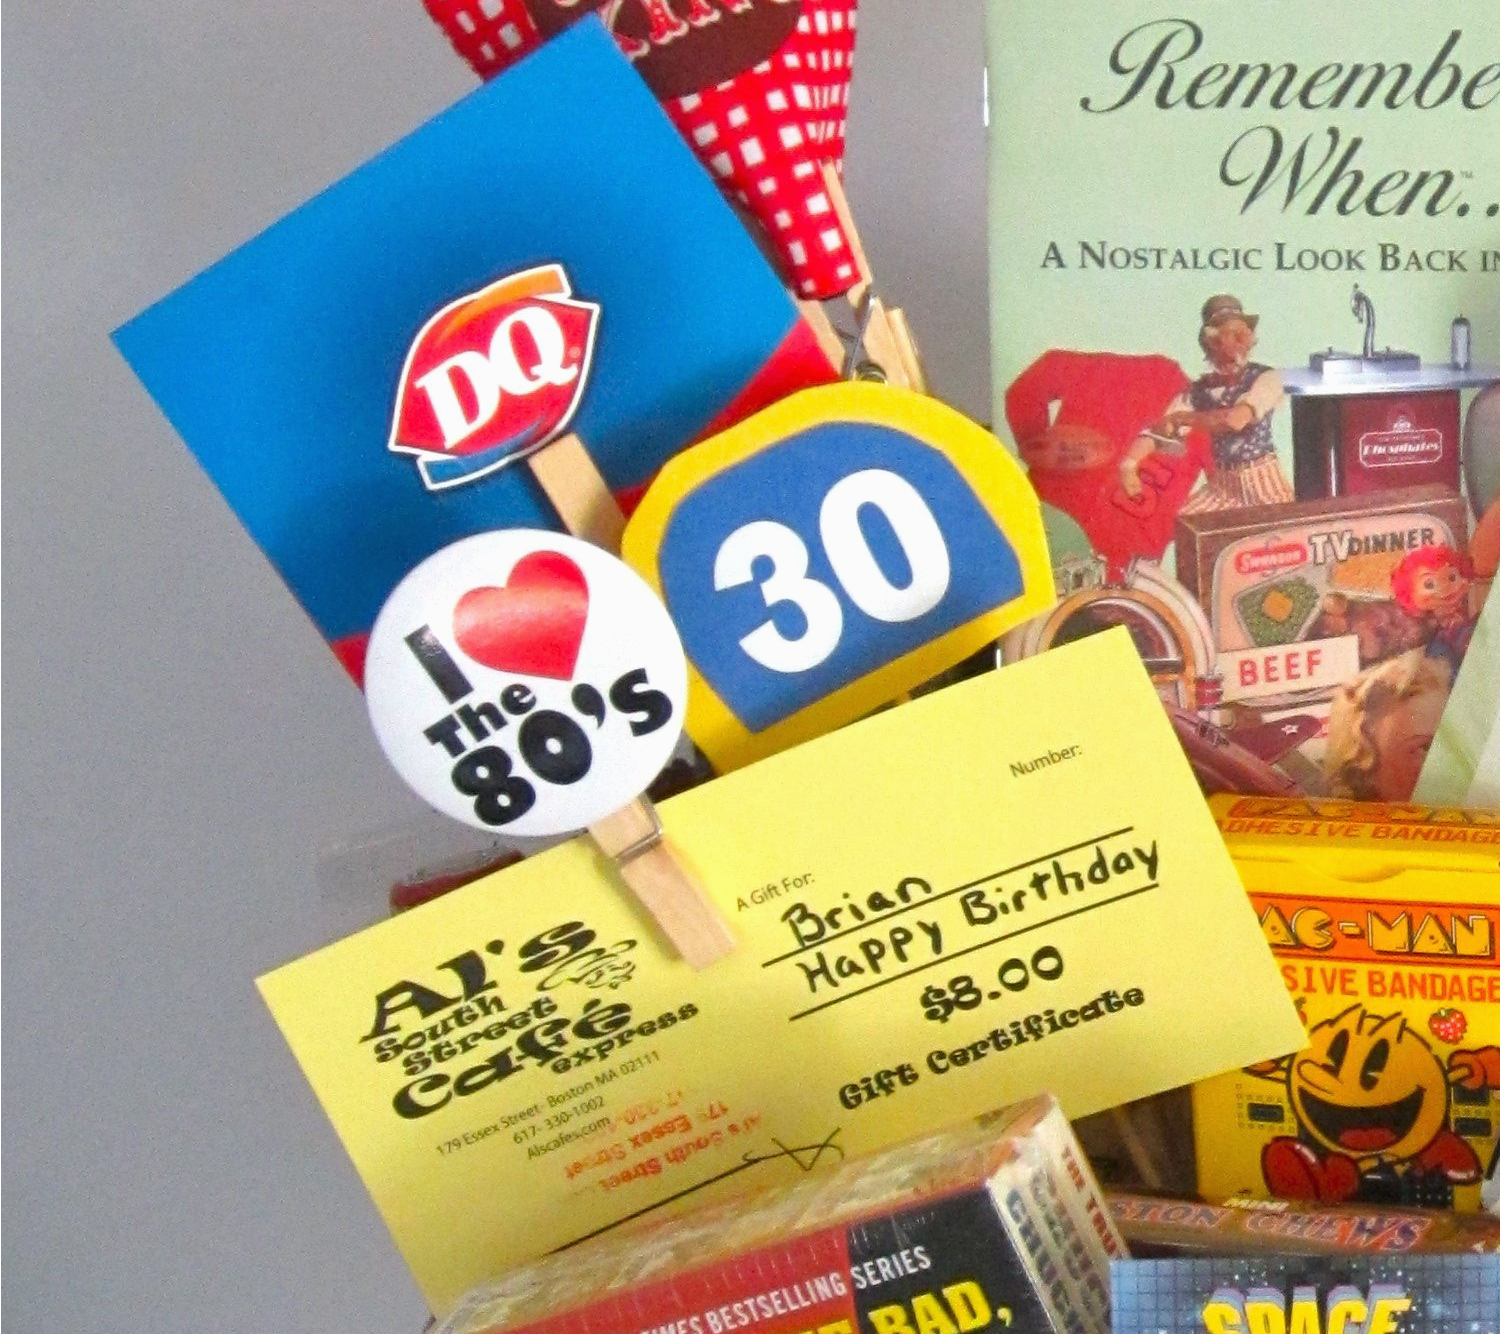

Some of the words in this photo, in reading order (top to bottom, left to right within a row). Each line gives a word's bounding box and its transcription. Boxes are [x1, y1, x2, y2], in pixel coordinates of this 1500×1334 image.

[1041, 242, 1065, 269] A
[416, 306, 579, 449] DQ
[714, 468, 950, 673] 30
[1308, 530, 1353, 566] TV
[1349, 528, 1435, 556] DINNER
[404, 625, 473, 705] I
[1239, 649, 1322, 687] BEEF
[423, 681, 537, 757] The
[1009, 742, 1082, 778] Number:
[735, 895, 750, 912] A
[751, 882, 780, 907] Gift
[782, 869, 816, 895] For:
[781, 876, 932, 947] Brian
[796, 918, 943, 993] Happy
[960, 840, 1159, 927] Birthday
[1258, 904, 1493, 960] AC-MAN
[920, 945, 1064, 1025] $8.00
[374, 995, 508, 1063] South
[403, 996, 558, 1076] Street
[838, 1062, 919, 1111] Gift
[926, 986, 1146, 1075] Certificate
[436, 1136, 462, 1156] 179
[463, 1122, 501, 1146] Essex
[546, 1079, 594, 1107] Boston
[596, 1067, 619, 1086] MA
[619, 1050, 661, 1076] 02111
[707, 1271, 847, 1334] BESTSELLING
[849, 1246, 932, 1292] SERIES
